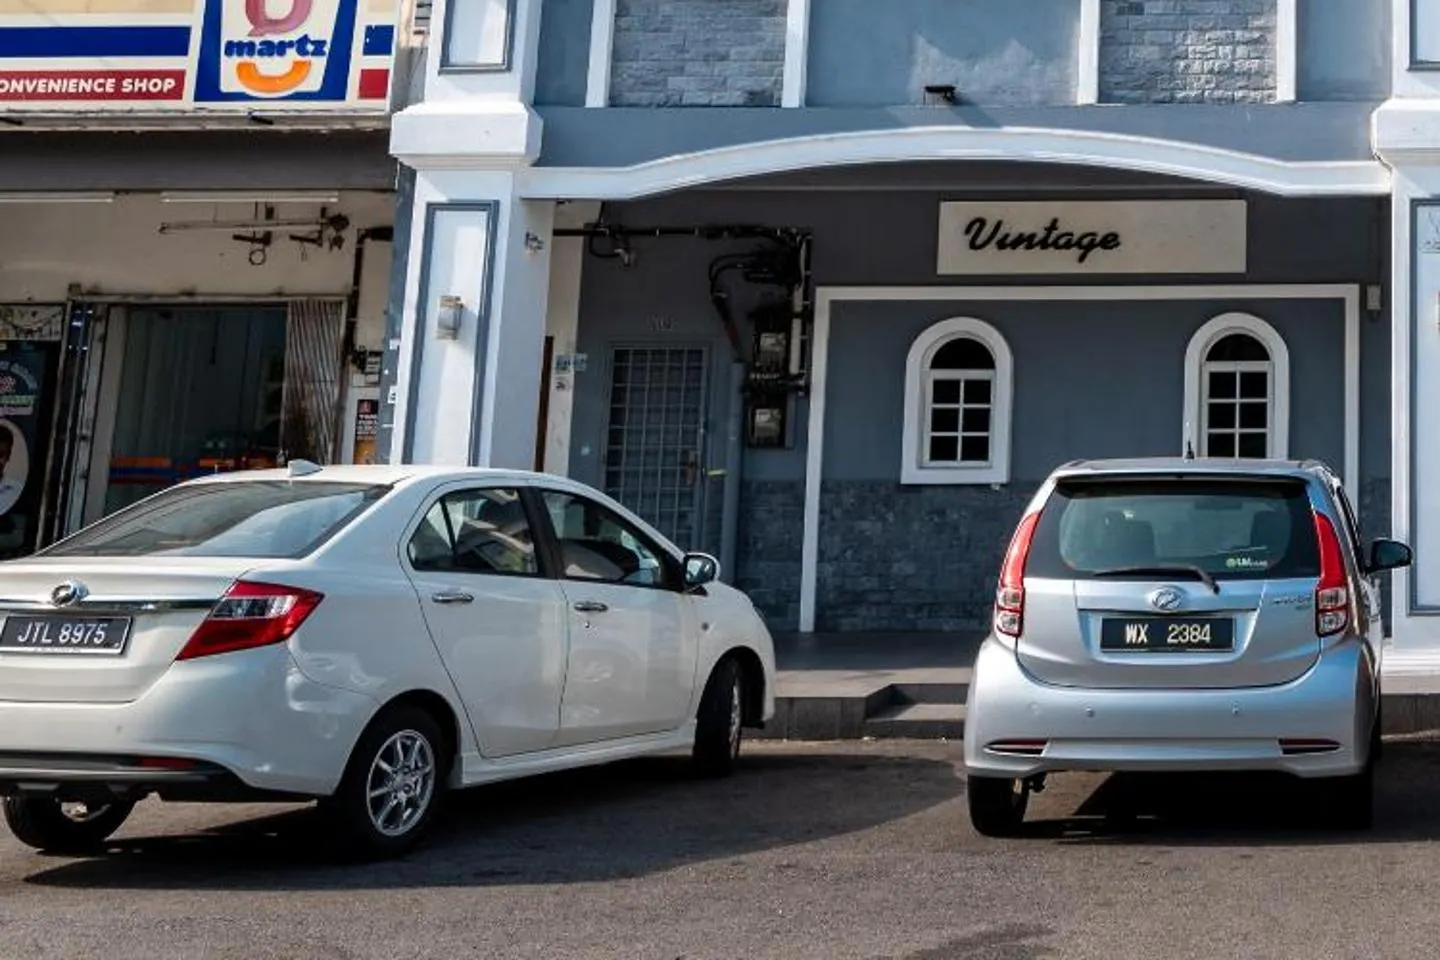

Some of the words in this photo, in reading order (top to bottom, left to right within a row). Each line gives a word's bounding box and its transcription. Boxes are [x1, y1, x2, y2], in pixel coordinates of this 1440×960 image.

[224, 34, 327, 57] martz
[121, 78, 175, 93] SHOP
[963, 217, 1121, 264] Vintage
[17, 622, 53, 644] JTL
[59, 623, 108, 644] 8975
[1125, 623, 1149, 644] WX
[1167, 623, 1211, 644] 2384
